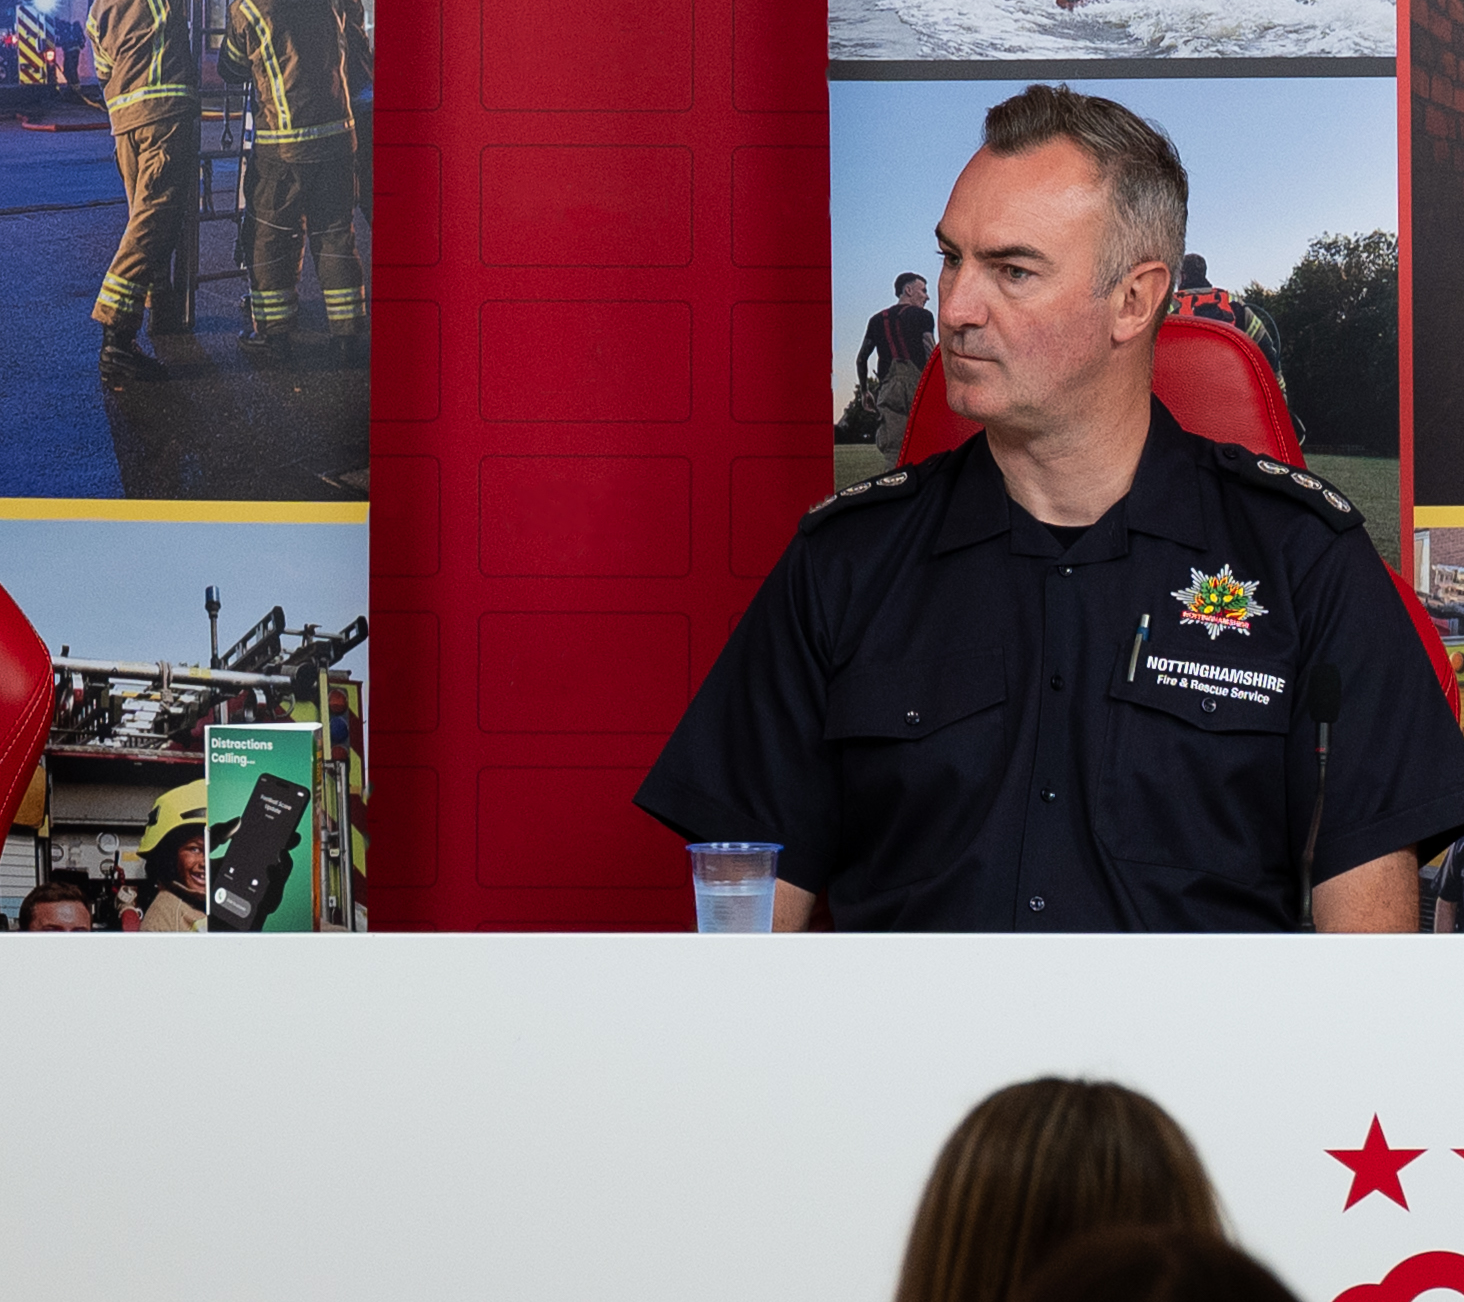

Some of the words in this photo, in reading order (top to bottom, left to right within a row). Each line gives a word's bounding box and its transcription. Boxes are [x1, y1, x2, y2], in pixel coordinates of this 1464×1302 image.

[1146, 655, 1286, 693] NOTTINGHAMSHIRE
[1157, 674, 1177, 686] Fire
[1179, 678, 1189, 689] &
[1190, 679, 1229, 697] Rescue
[1230, 687, 1270, 705] Service
[211, 737, 273, 751] Distractions
